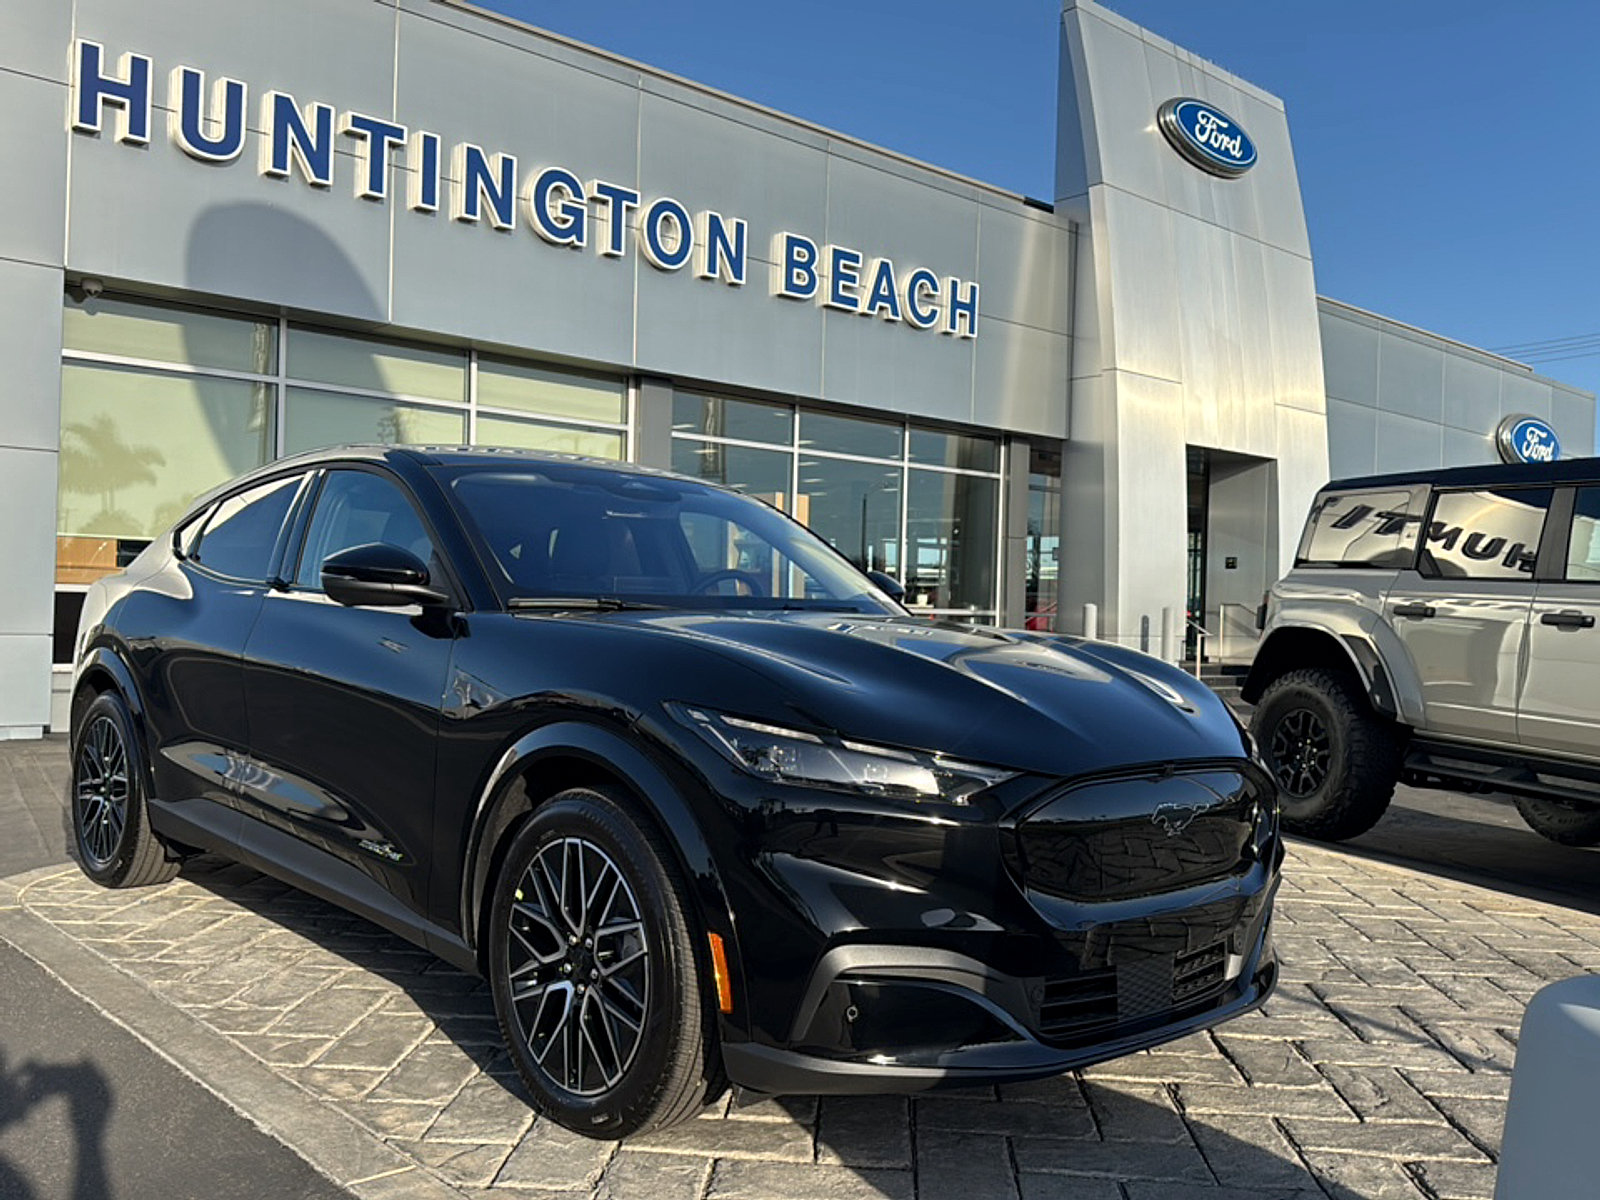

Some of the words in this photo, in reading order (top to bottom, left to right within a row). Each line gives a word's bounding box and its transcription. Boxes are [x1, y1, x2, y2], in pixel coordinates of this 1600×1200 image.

[1195, 110, 1243, 158] Ford
[71, 39, 748, 286] HUNTINGTON
[773, 231, 980, 339] BEACH
[1522, 426, 1555, 461] Ford
